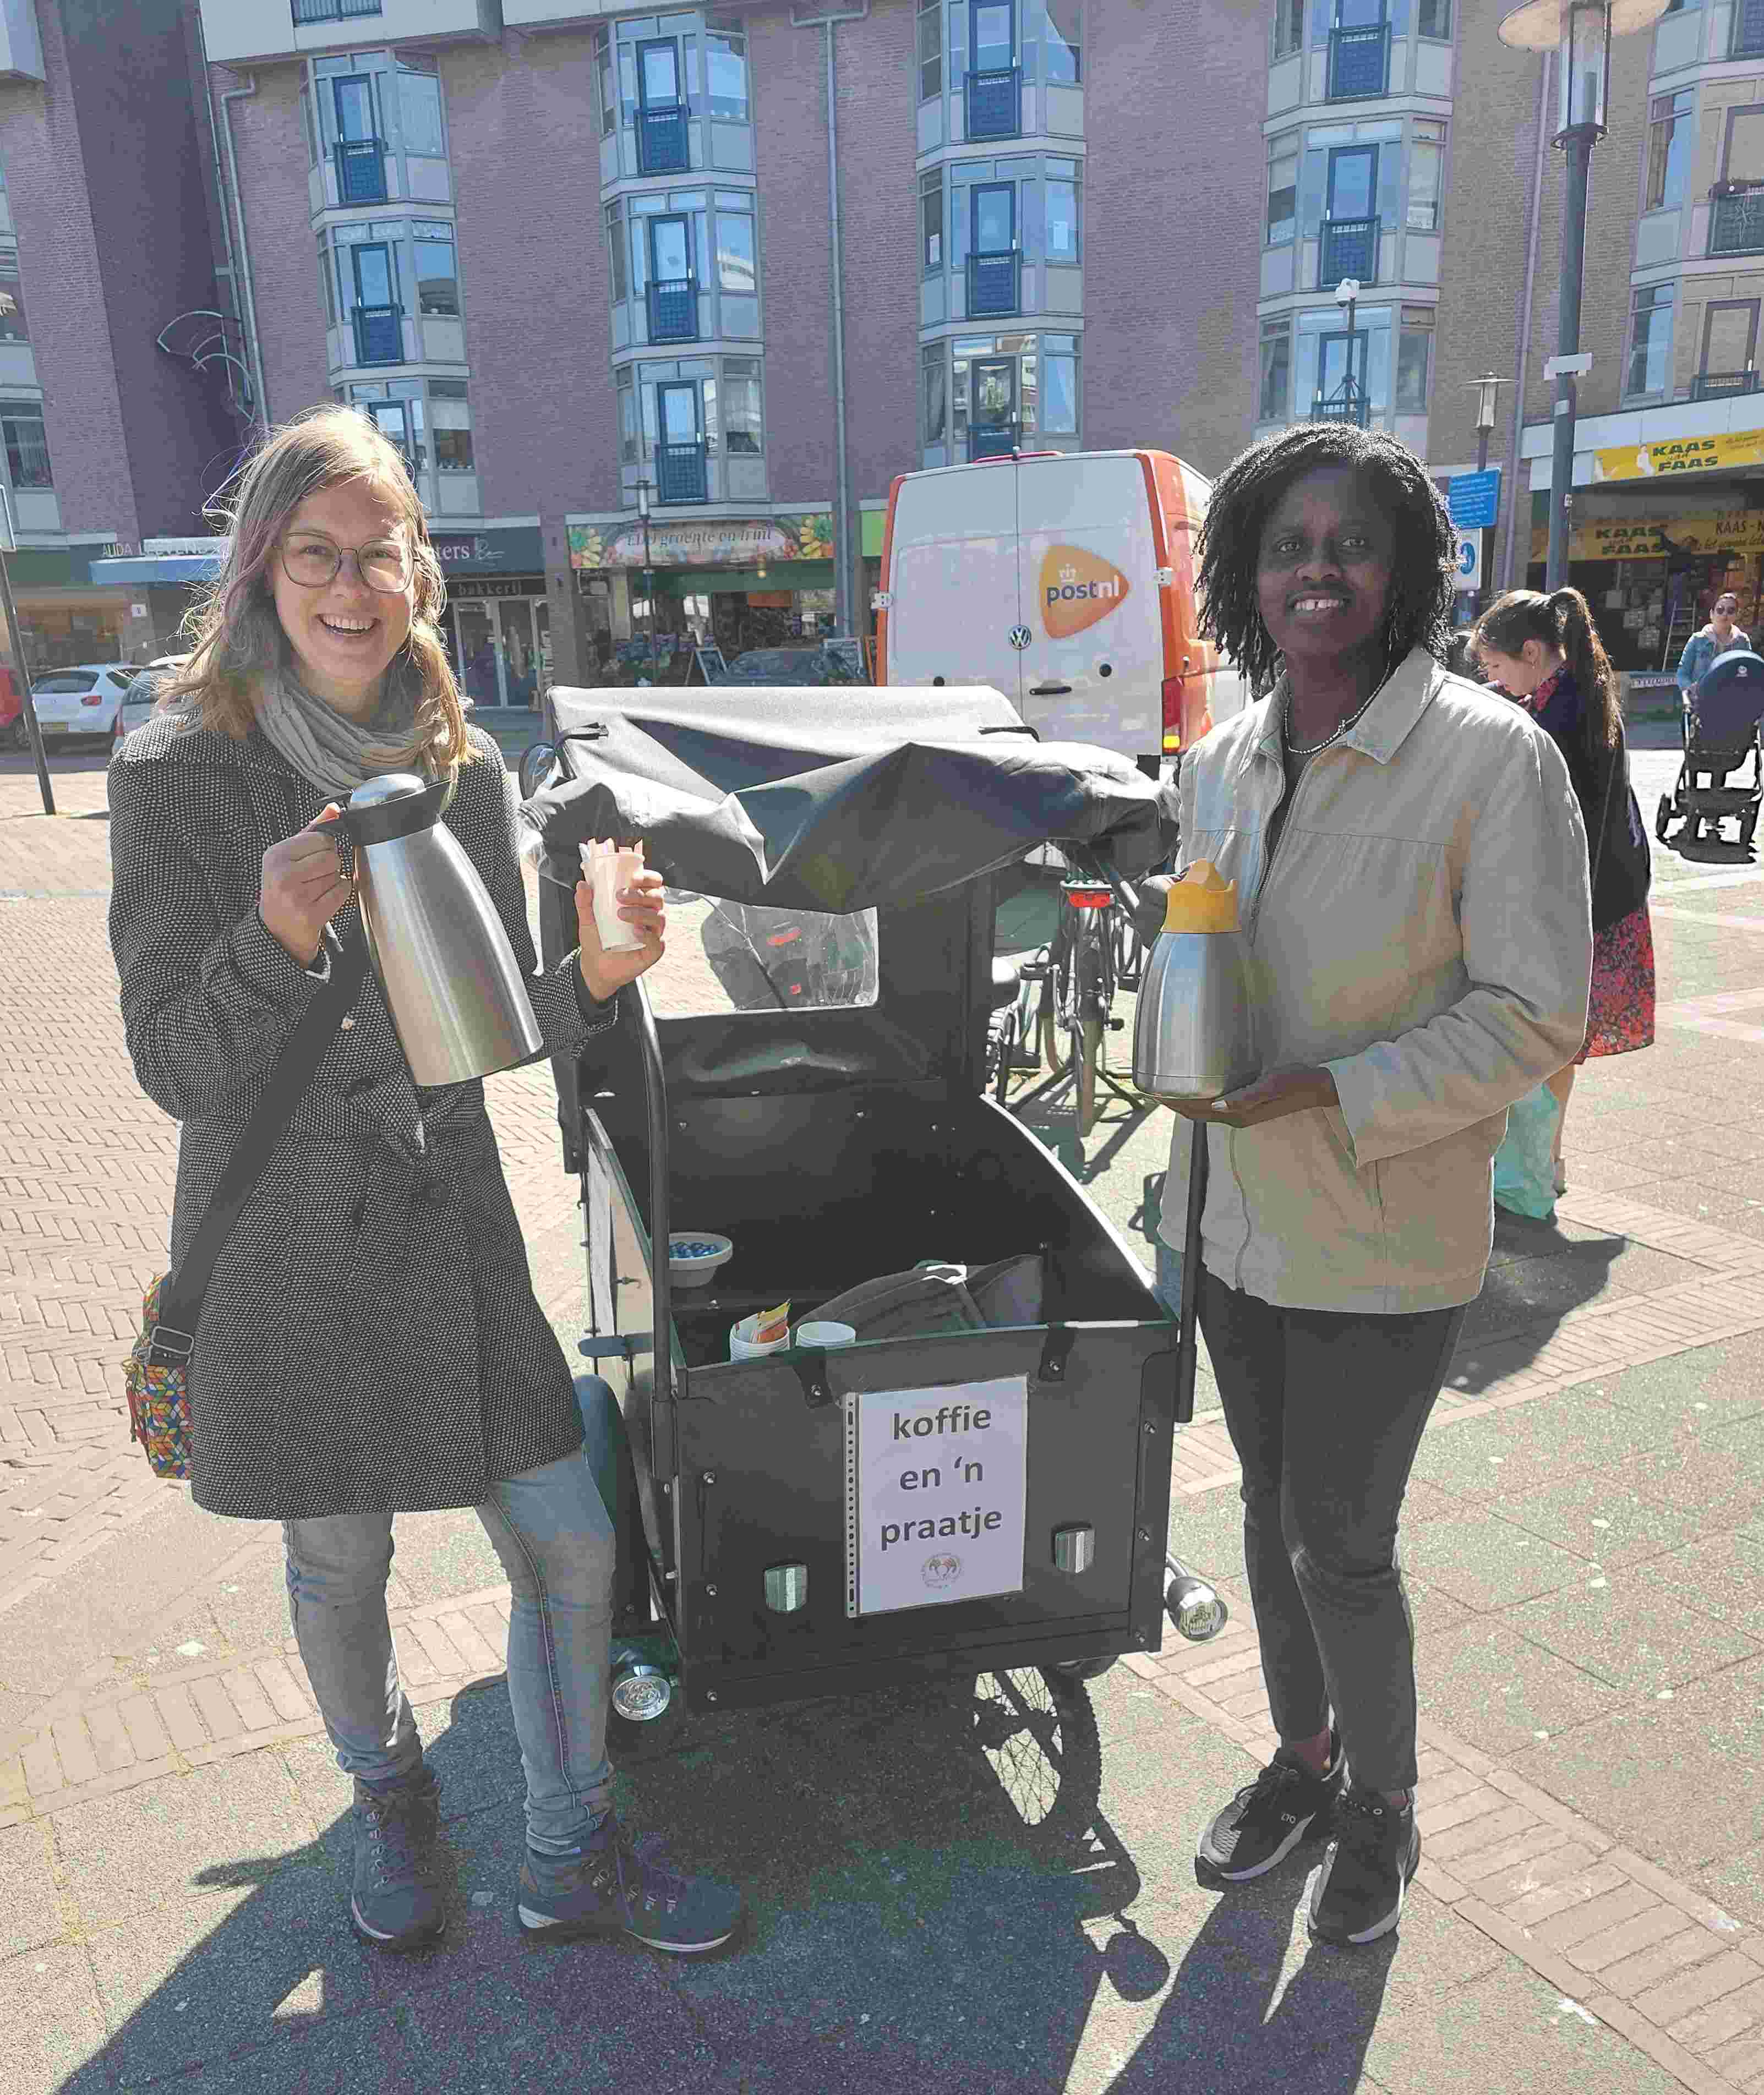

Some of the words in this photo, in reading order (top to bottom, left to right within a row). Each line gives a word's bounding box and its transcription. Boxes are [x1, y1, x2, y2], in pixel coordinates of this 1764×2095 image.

[1653, 440, 1716, 456] KAAS
[1658, 456, 1718, 472] FAAS
[1596, 526, 1662, 539] KAAS
[1716, 520, 1747, 535] KAAS
[1602, 544, 1662, 555] FAAS
[458, 580, 522, 596] bakkerij
[1047, 575, 1119, 608] postnl
[893, 1405, 991, 1440] koffie
[899, 1467, 941, 1490] en
[881, 1506, 1002, 1551] praatje
